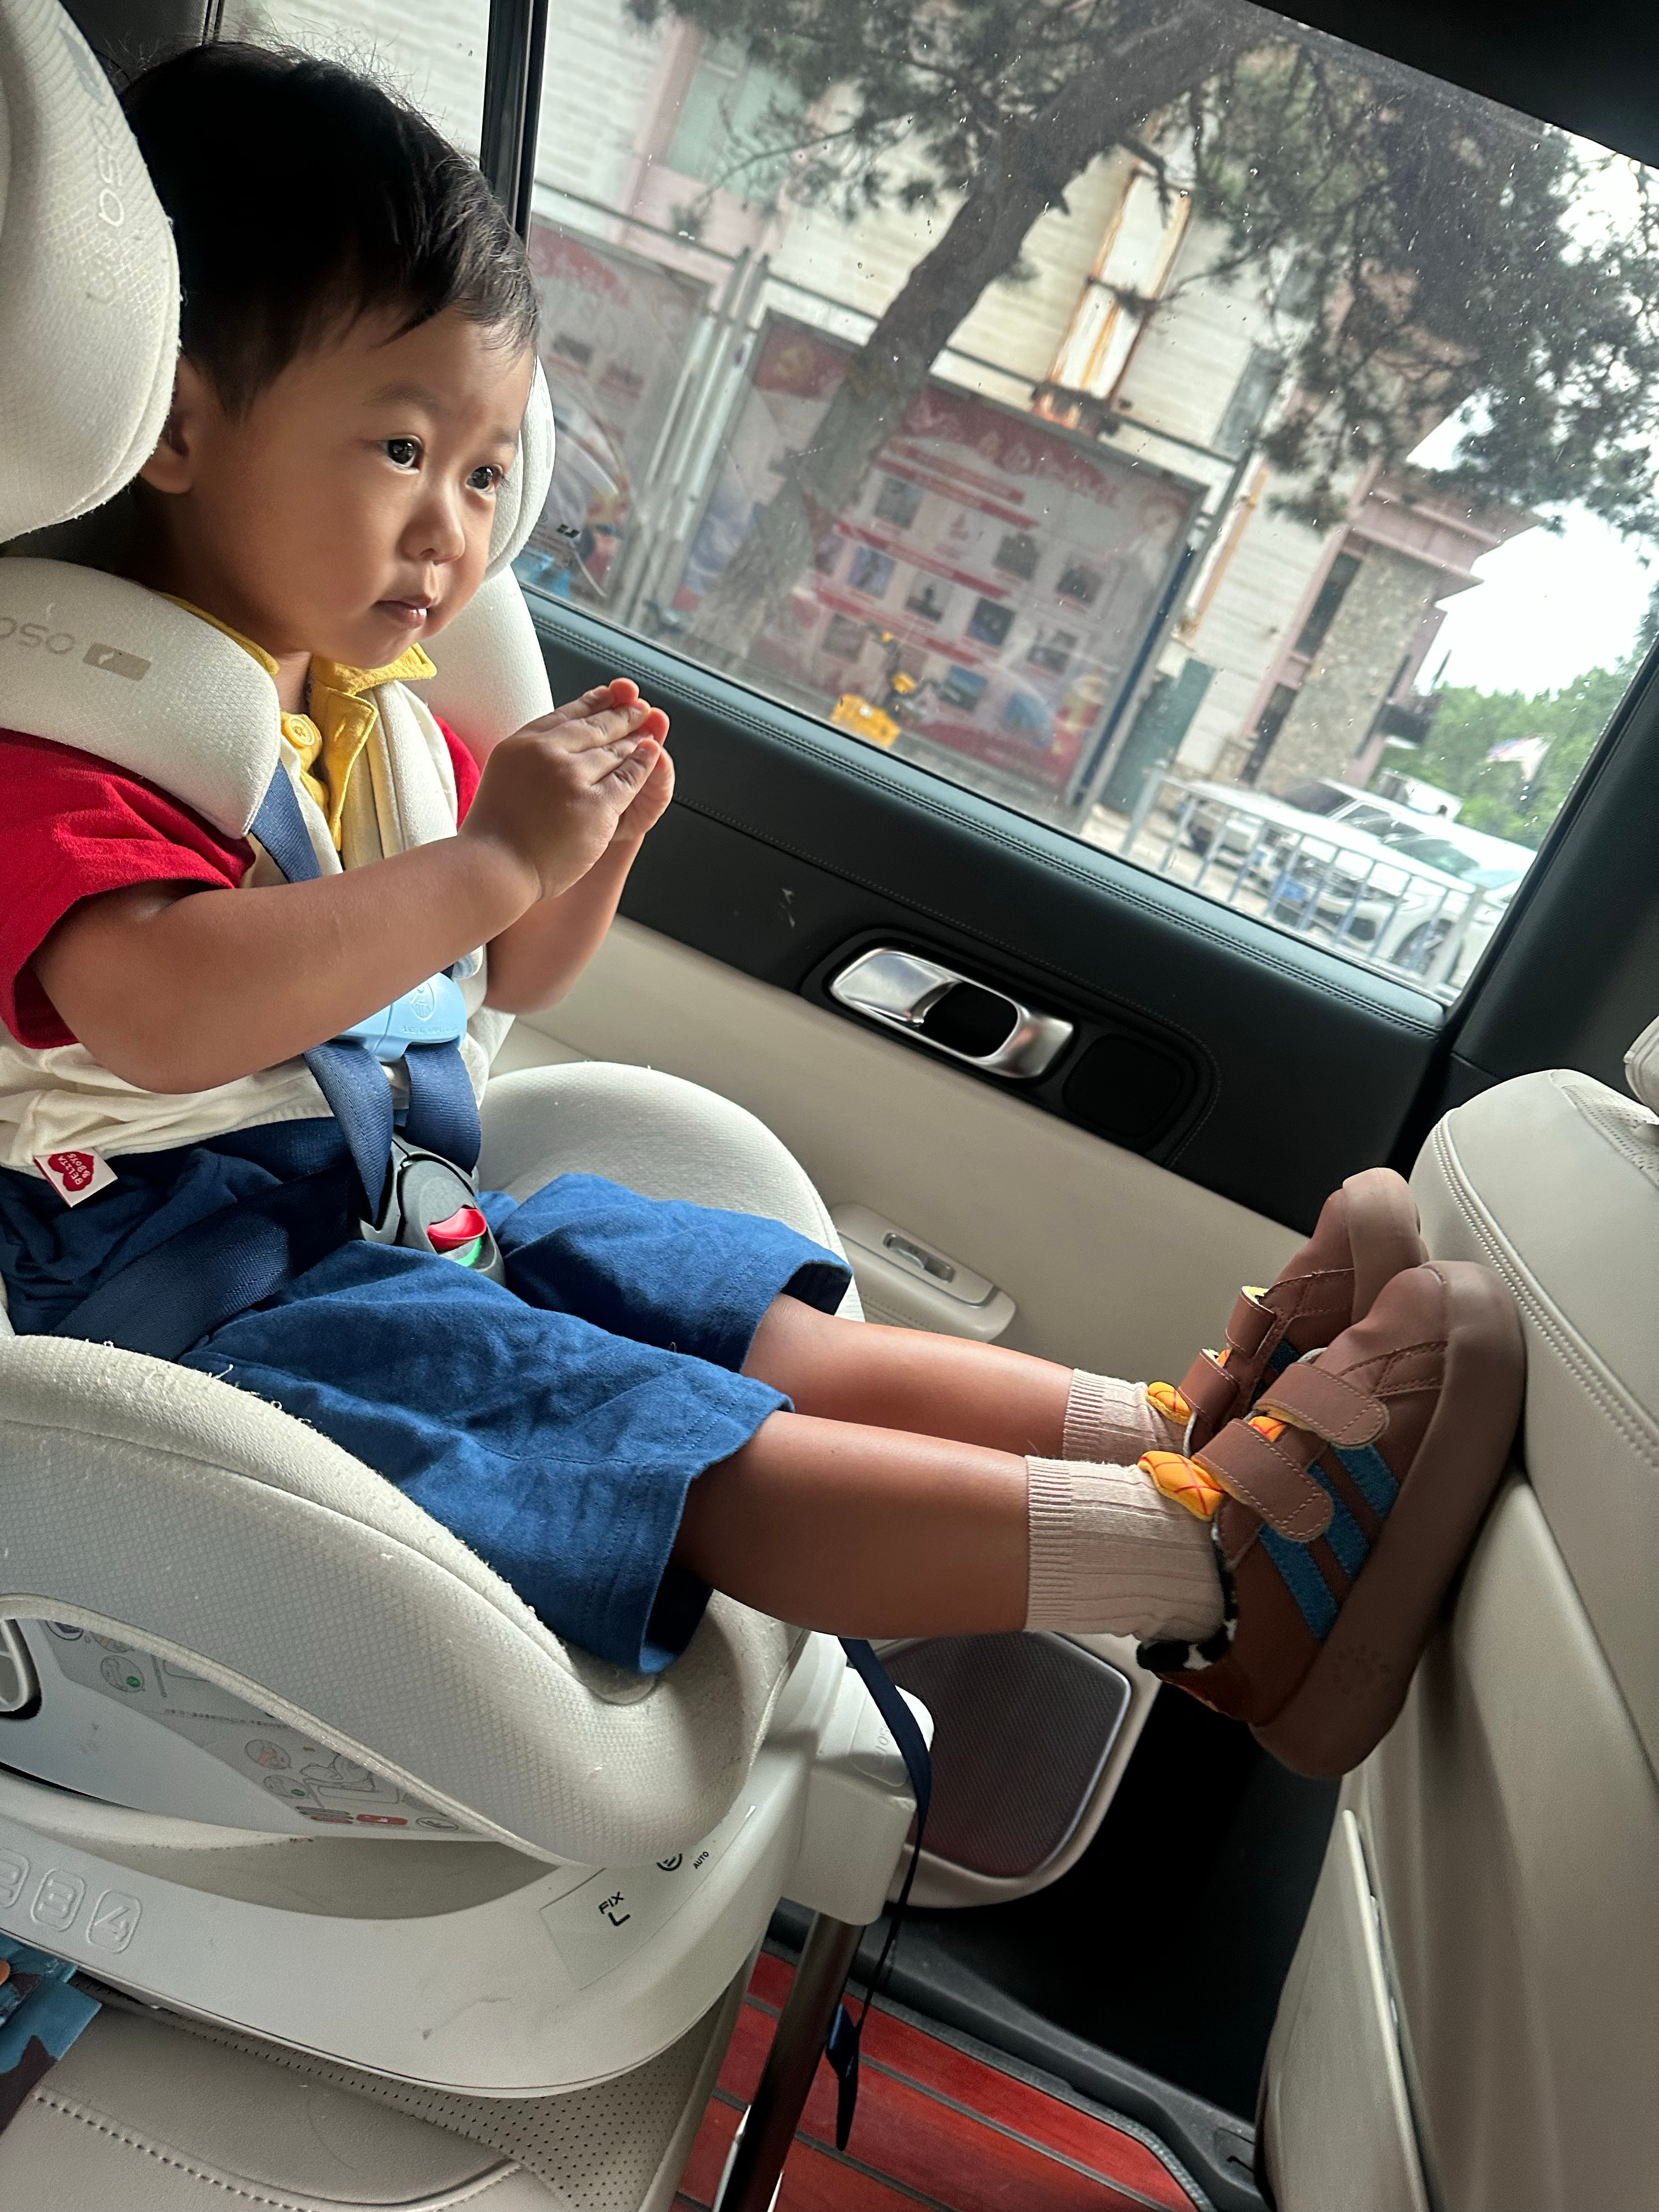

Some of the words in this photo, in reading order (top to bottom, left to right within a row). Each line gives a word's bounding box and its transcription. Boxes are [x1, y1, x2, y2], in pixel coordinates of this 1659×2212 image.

[58, 1155, 84, 1185] BELITA
[693, 1851, 709, 1869] AUTO
[598, 1892, 624, 1914] FIX
[93, 1905, 129, 1942] 4
